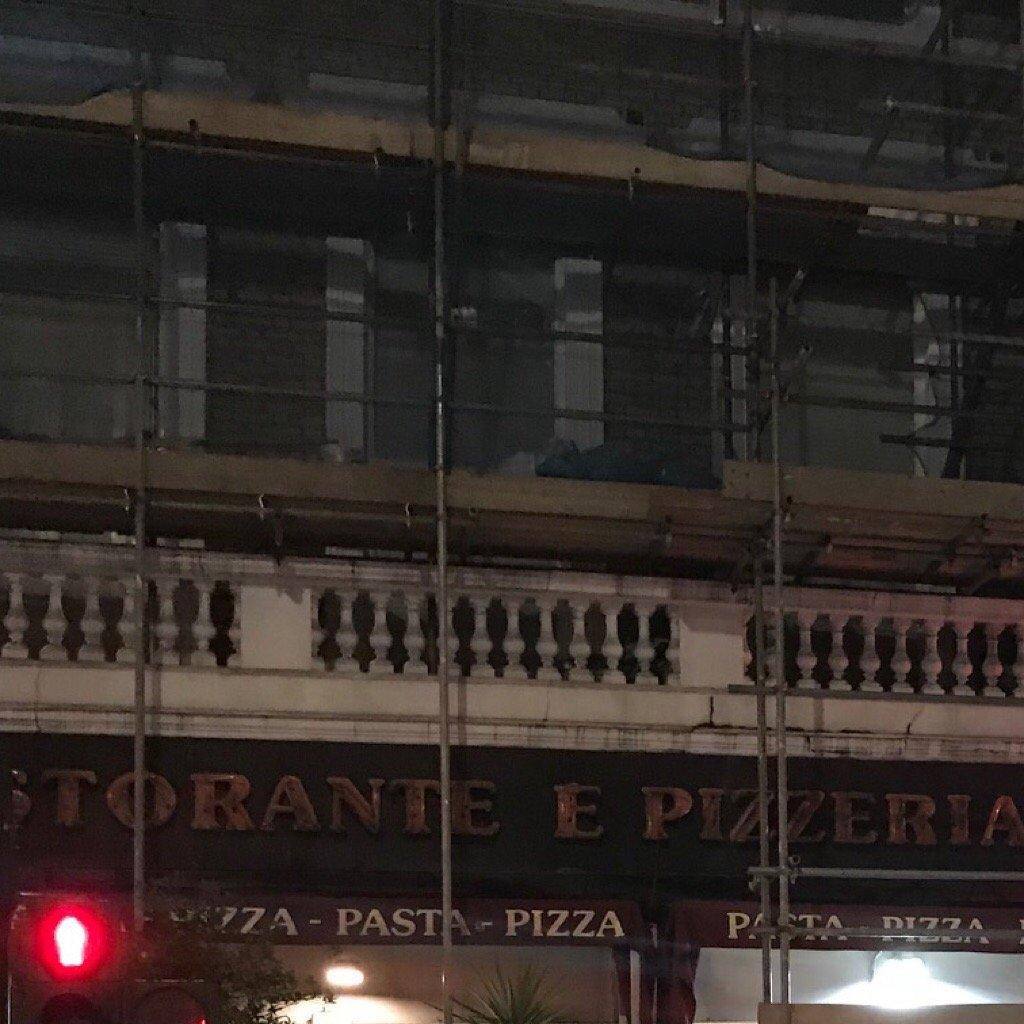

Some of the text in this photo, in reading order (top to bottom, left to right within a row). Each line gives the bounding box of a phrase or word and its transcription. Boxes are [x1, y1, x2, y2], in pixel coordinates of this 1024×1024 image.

[552, 782, 605, 839] E
[336, 908, 471, 937] PASTA
[504, 909, 626, 938] PIZZA
